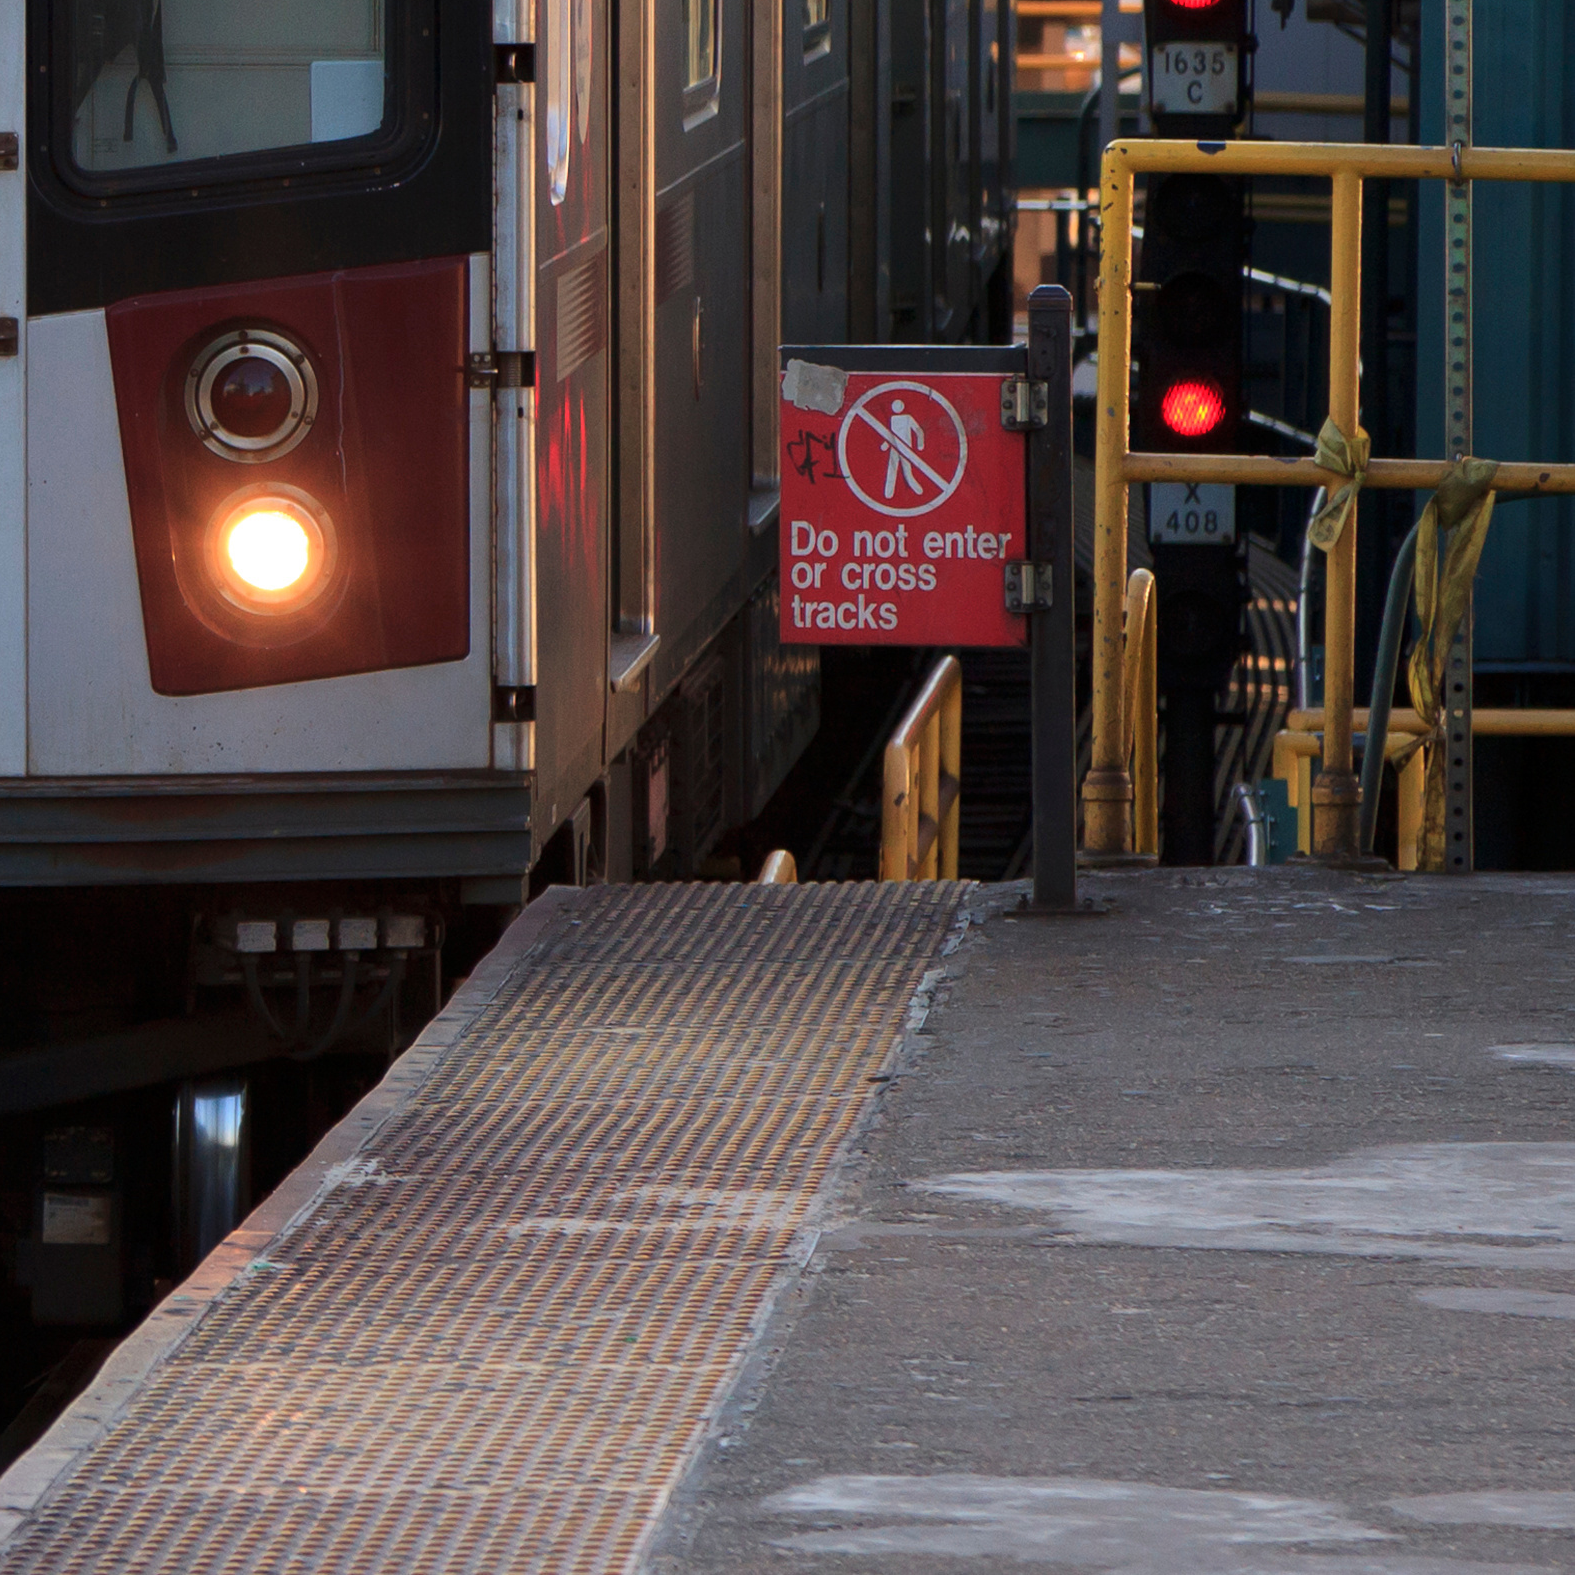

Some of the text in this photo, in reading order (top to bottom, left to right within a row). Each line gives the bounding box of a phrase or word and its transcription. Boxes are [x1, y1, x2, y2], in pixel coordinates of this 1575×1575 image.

[1165, 50, 1225, 75] 1635
[1187, 80, 1203, 104] C
[1166, 510, 1218, 535] 408
[790, 520, 1012, 559] Do not enter
[790, 561, 937, 591] or cross
[791, 593, 899, 630] tracks
